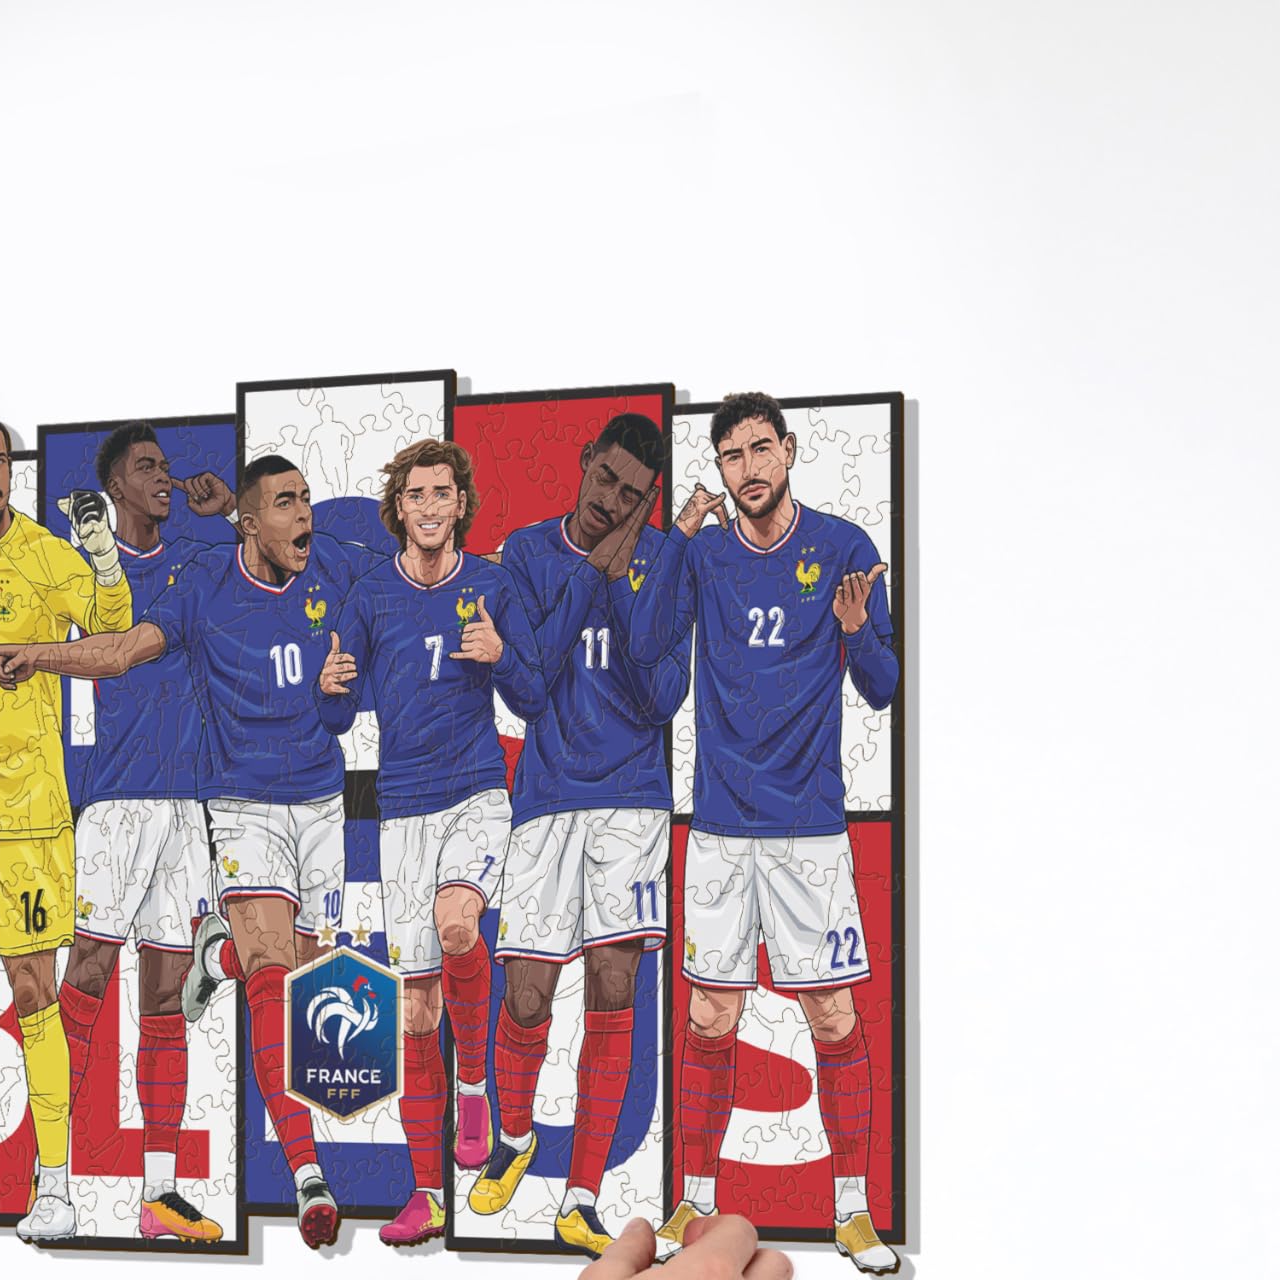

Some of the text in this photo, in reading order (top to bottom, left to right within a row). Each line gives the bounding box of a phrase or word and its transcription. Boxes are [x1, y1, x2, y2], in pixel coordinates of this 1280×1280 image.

[581, 626, 610, 670] 11
[748, 606, 785, 648] 22
[270, 642, 303, 689] 10
[424, 634, 444, 681] 7
[478, 854, 496, 883] 7
[20, 888, 48, 935] 16
[323, 888, 341, 919] 10
[631, 880, 659, 923] 11
[826, 926, 863, 969] 22
[306, 1068, 382, 1084] FRANCE
[326, 1088, 361, 1100] FFF
